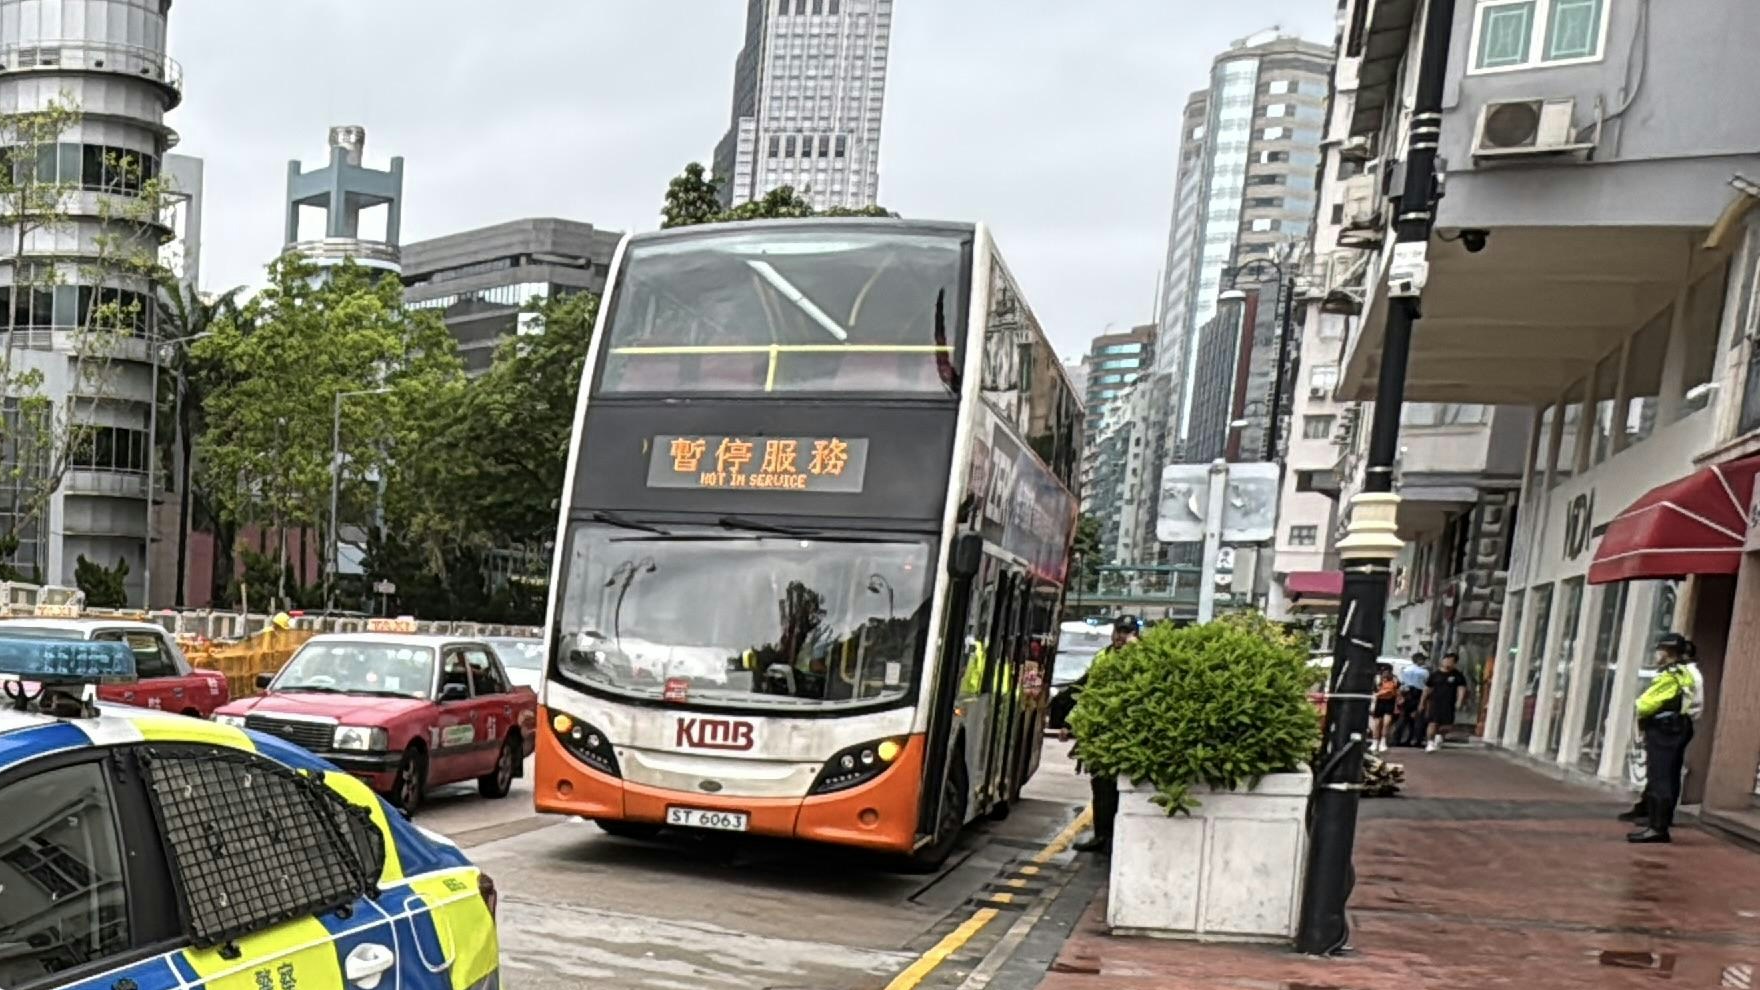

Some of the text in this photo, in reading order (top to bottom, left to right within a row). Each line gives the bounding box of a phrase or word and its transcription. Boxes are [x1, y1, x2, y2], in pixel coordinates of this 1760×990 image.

[670, 438, 848, 474] 暫停服務
[701, 472, 807, 488] NOT IN SERVICE
[676, 717, 755, 751] KMB
[672, 810, 743, 829] ST 6063
